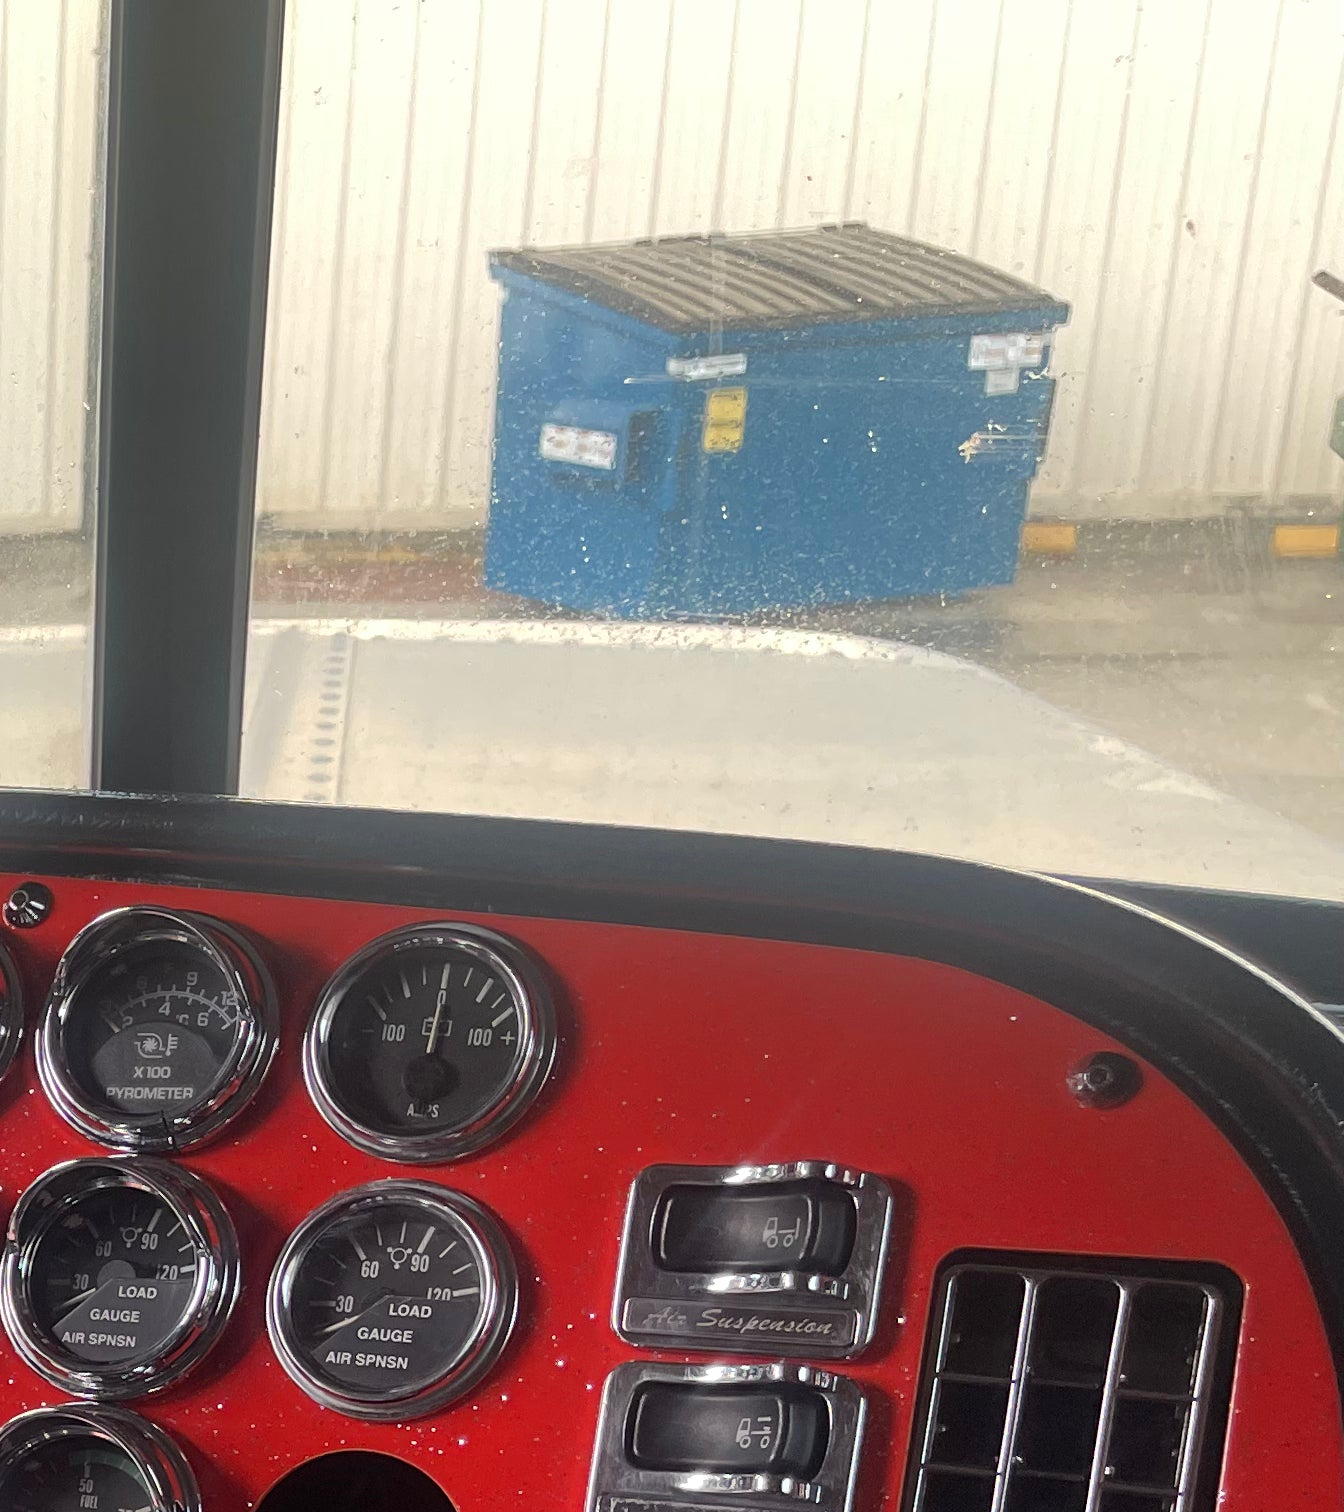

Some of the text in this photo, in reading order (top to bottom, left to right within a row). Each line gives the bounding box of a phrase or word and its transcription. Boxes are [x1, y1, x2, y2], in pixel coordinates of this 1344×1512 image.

[382, 1024, 405, 1042] 100
[468, 1028, 492, 1047] 100
[106, 1087, 194, 1099] PYROMETER
[407, 1104, 440, 1118] AS
[141, 1234, 158, 1250] 90
[361, 1261, 380, 1278] 60
[410, 1255, 430, 1272] 90
[118, 1286, 157, 1299] LOAD
[336, 1296, 353, 1313] 30
[389, 1304, 432, 1318] LOAD
[90, 1308, 140, 1323] GAUGE
[643, 1306, 834, 1335] Air Suspension
[61, 1331, 136, 1347] AIR SPNSN
[357, 1327, 413, 1343] GAUGE
[326, 1351, 409, 1369] AIR SPNSN
[80, 1495, 98, 1509] FUEL
